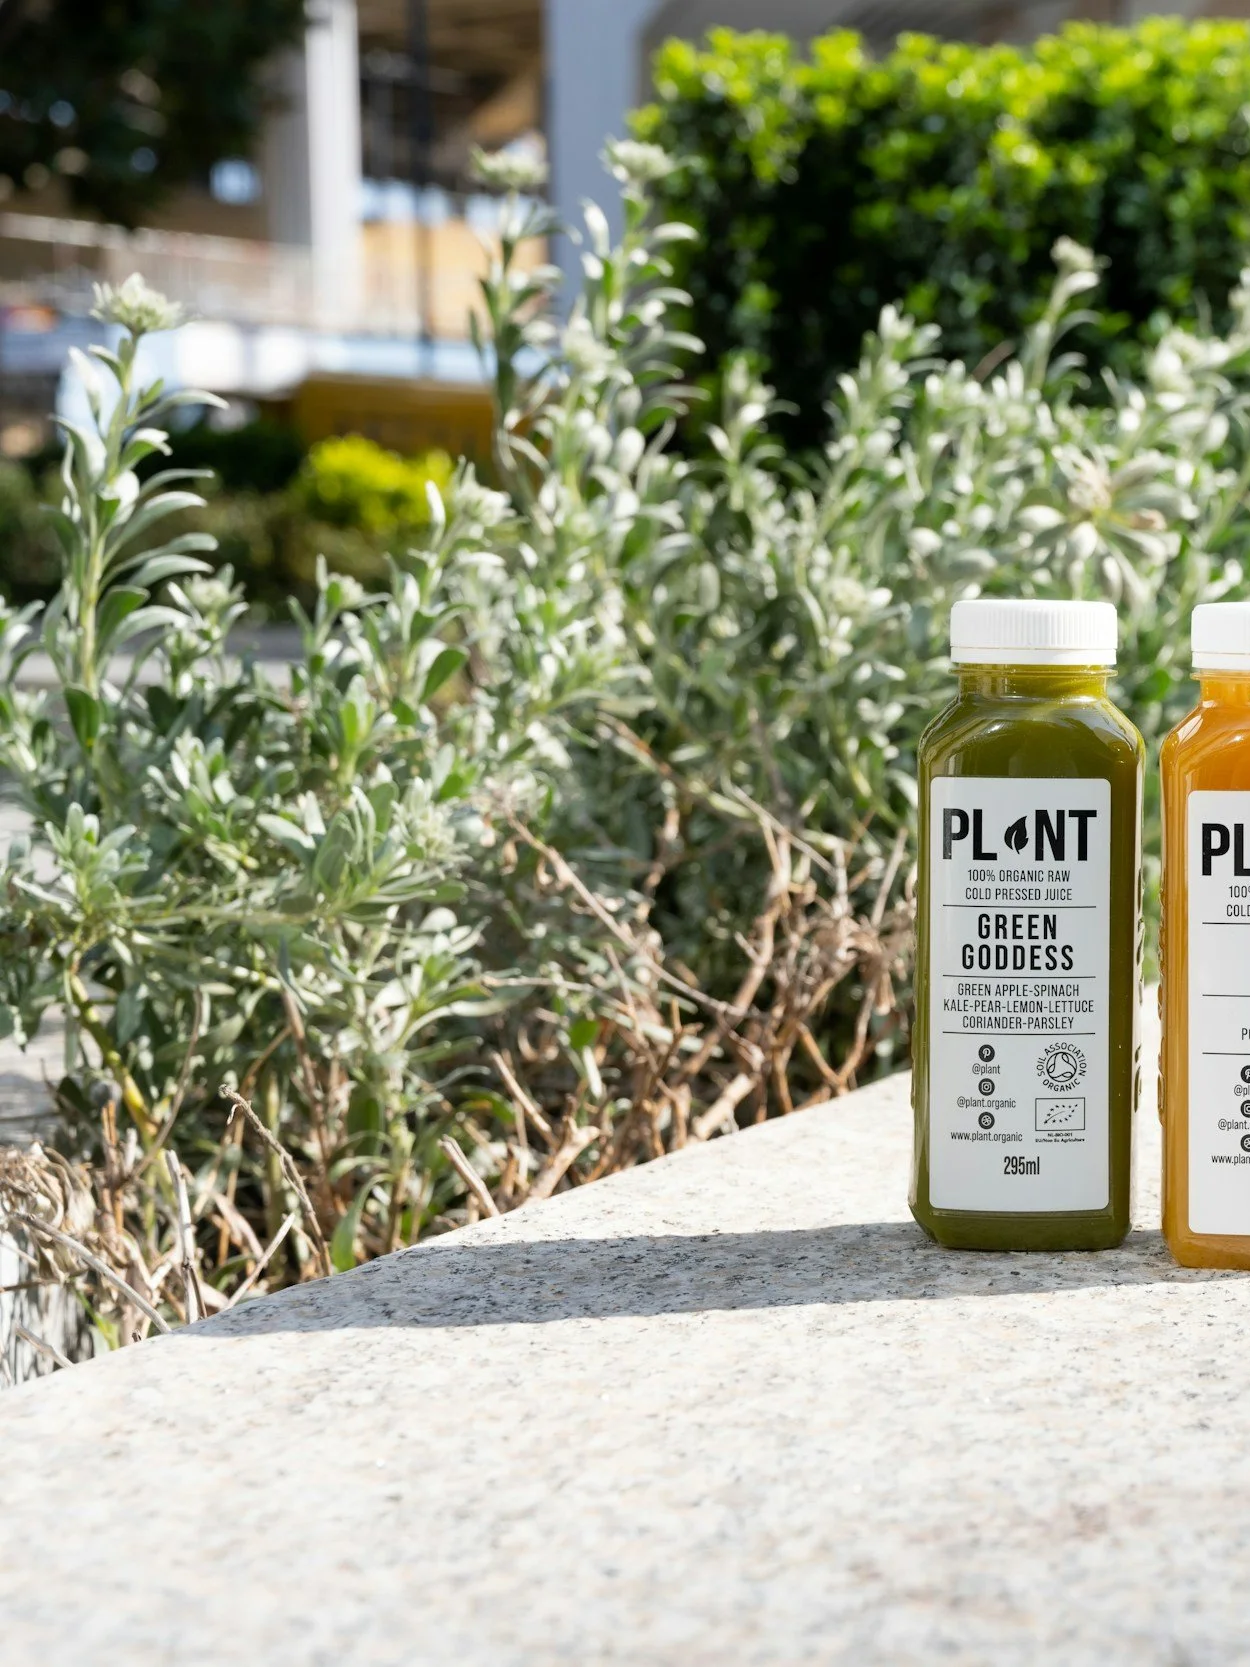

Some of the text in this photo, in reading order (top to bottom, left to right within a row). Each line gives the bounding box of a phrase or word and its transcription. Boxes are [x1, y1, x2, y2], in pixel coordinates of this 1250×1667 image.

[968, 870, 1070, 882] 100% ORGANIC RAW
[965, 888, 1072, 900] COLD PRESSED JUICE
[978, 914, 1057, 940] GREEN
[962, 945, 1073, 970] GODDESS
[958, 983, 1080, 997] GREEN APPLE-SPINACH
[944, 999, 1094, 1013] KALE-PEAR-LEMON-LETTUCE
[962, 1016, 1074, 1029] CORIANDER-PARSLEY
[1036, 1042, 1087, 1076] SOIL ASSOCIATION
[972, 1064, 1000, 1075] @plant
[1042, 1078, 1080, 1092] ORGANIC
[957, 1096, 1016, 1108] @plant.organic
[951, 1131, 1023, 1143] www.plant.organic
[1004, 1156, 1040, 1175] 295ml
